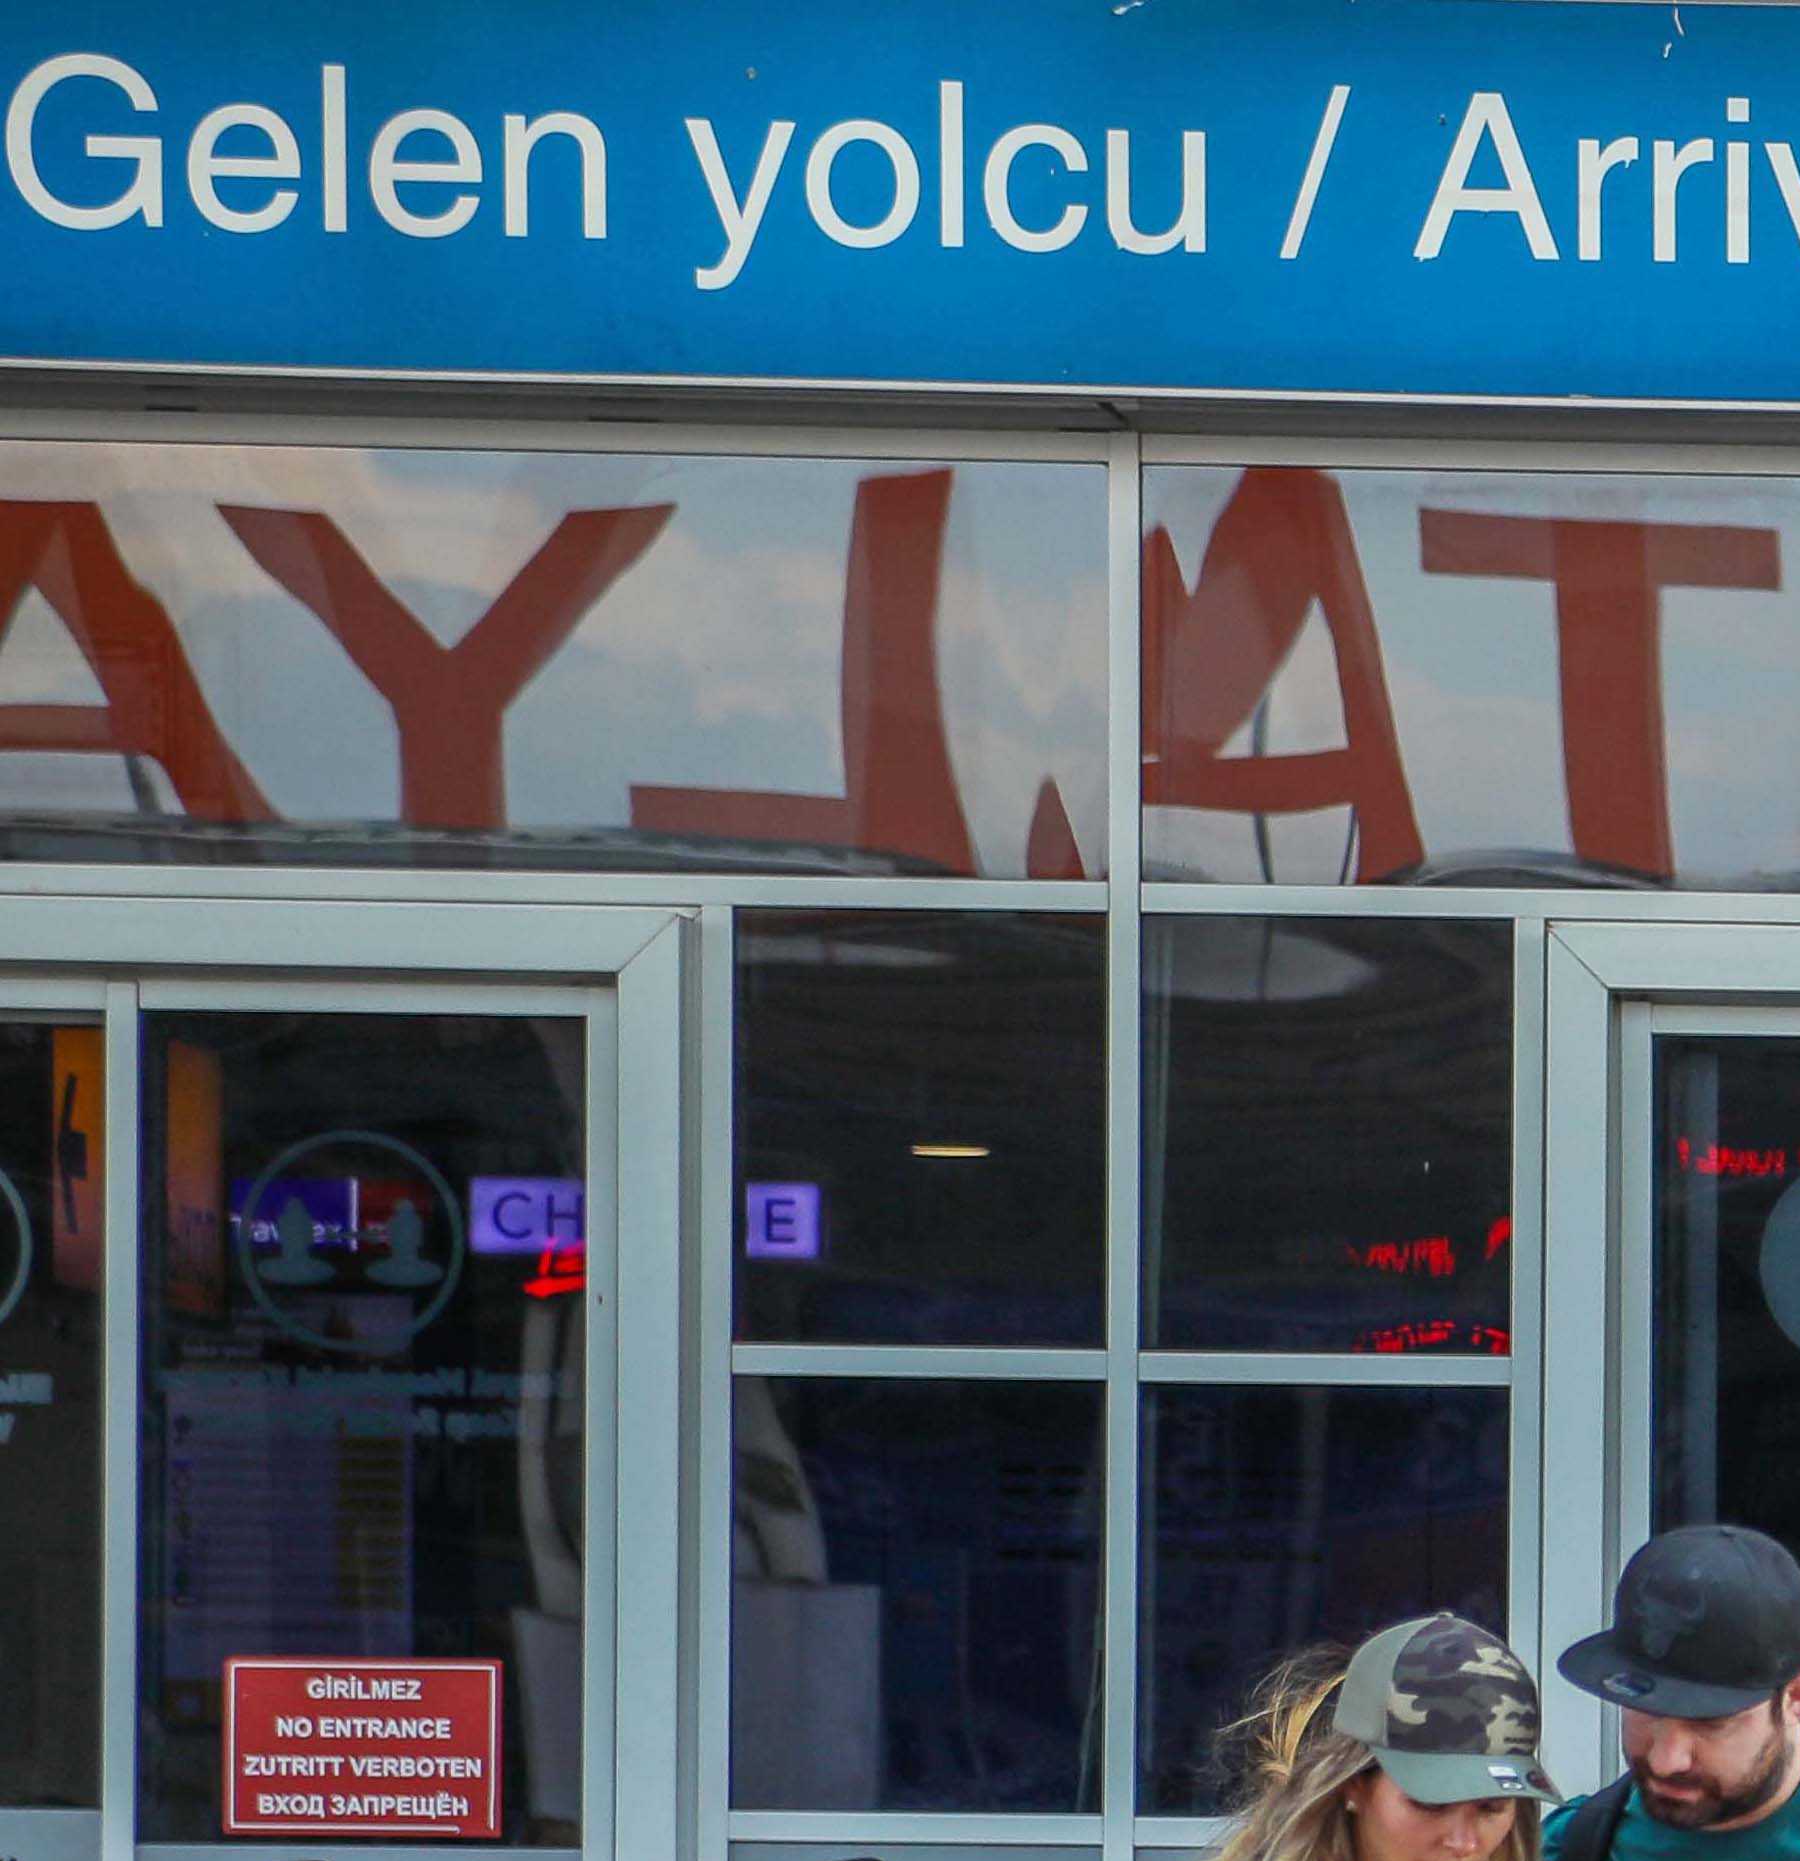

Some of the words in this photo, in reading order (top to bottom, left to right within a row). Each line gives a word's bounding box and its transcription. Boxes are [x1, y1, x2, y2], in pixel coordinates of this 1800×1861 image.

[5, 53, 606, 239] Gelen
[685, 79, 1207, 292] yolcu
[1280, 84, 1351, 260] /
[307, 1674, 422, 1701] GİRİLMEZ
[276, 1716, 313, 1739] NO
[319, 1717, 451, 1740] ENTRANCE
[243, 1755, 344, 1777] ZUTRITT
[350, 1757, 483, 1778] VERBOTEN
[257, 1794, 325, 1819] ВХОД
[331, 1791, 470, 1820] ЗАПРЕЩЁН
